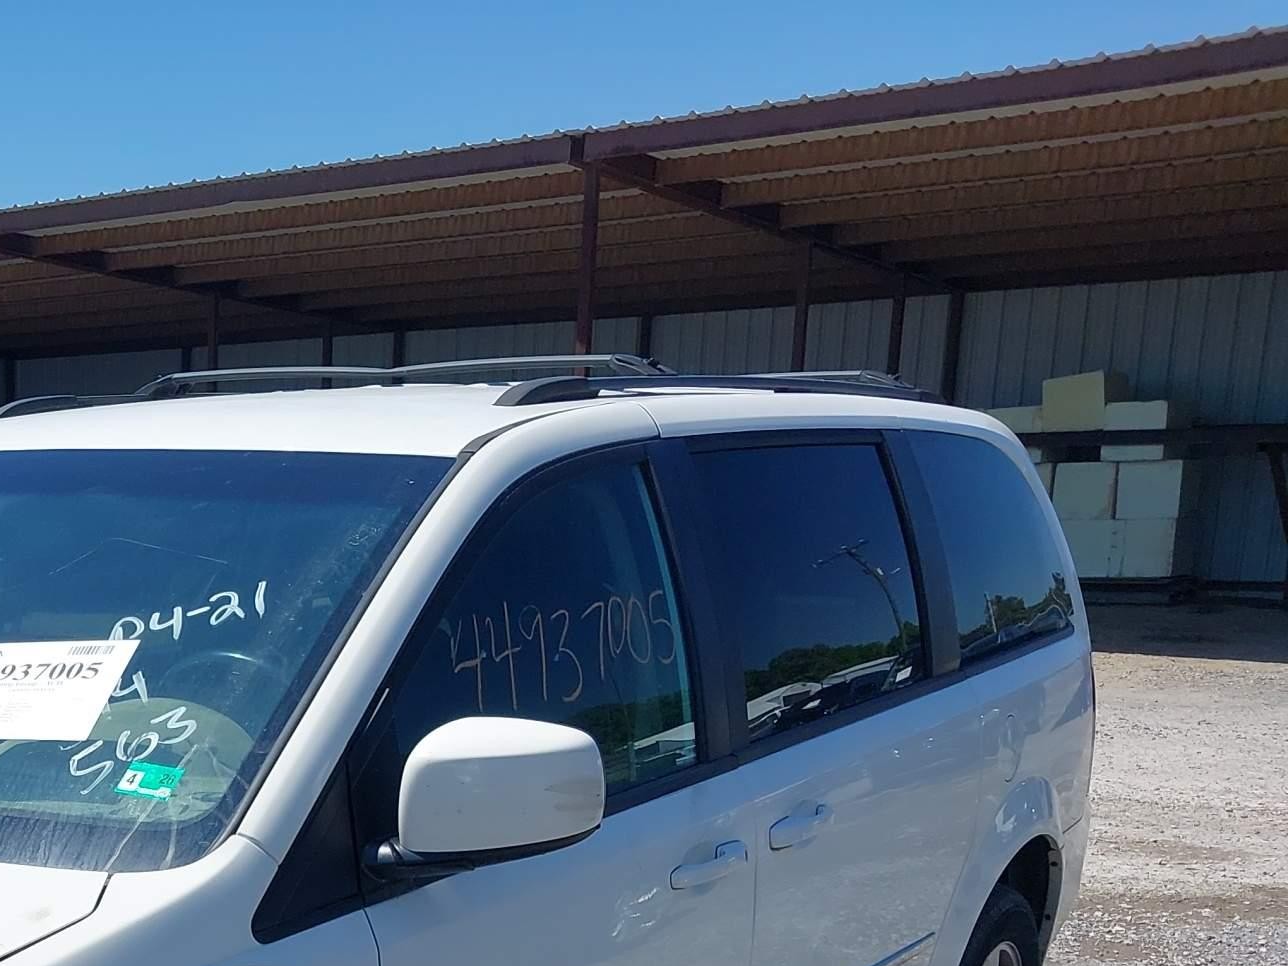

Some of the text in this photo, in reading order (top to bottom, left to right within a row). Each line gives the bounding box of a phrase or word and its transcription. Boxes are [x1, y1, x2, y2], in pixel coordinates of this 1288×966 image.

[450, 590, 677, 712] 44937005
[70, 706, 198, 795] 563
[127, 773, 138, 785] 4
